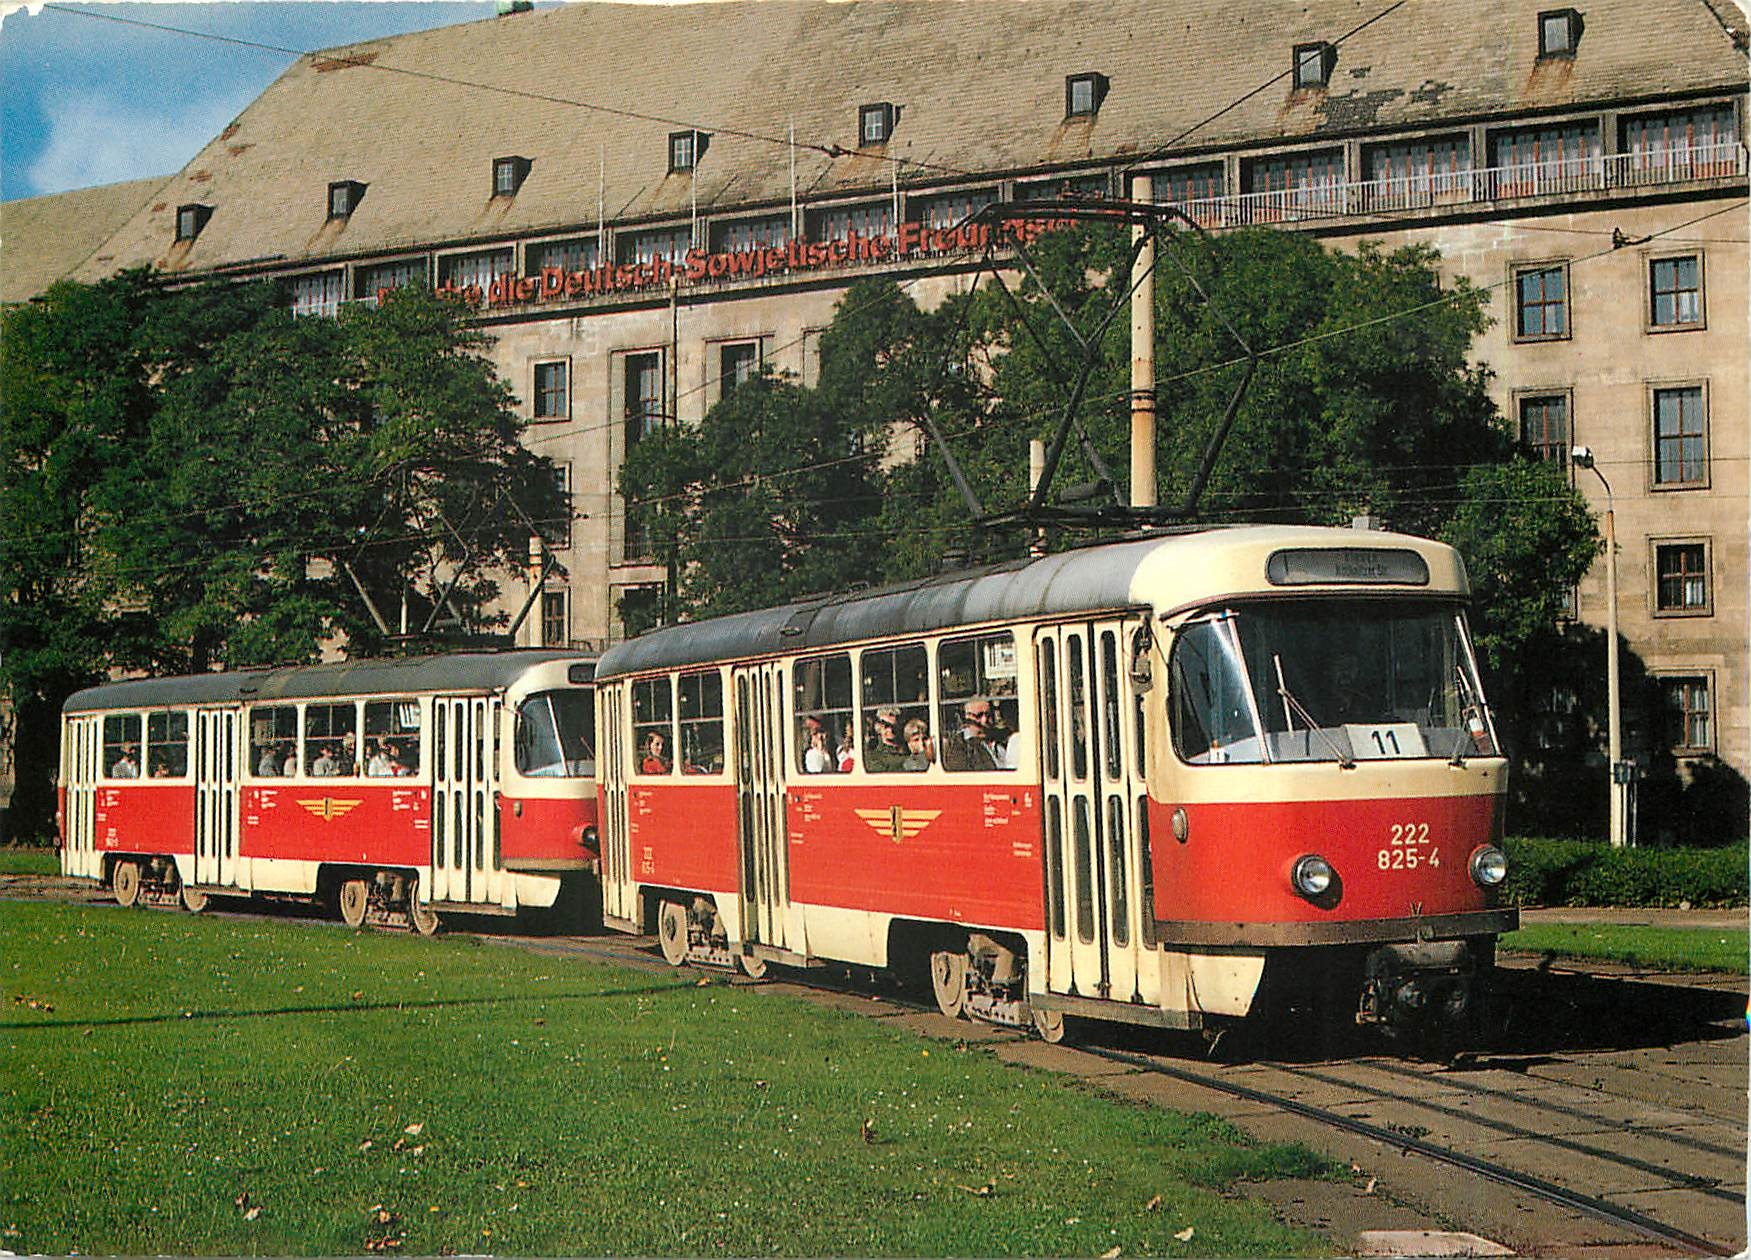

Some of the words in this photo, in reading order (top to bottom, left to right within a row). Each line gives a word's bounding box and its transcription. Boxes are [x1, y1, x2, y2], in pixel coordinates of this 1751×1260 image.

[488, 271, 535, 306] die
[1371, 730, 1401, 754] 11
[1391, 824, 1430, 845] 222
[1377, 848, 1440, 870] 825-4
